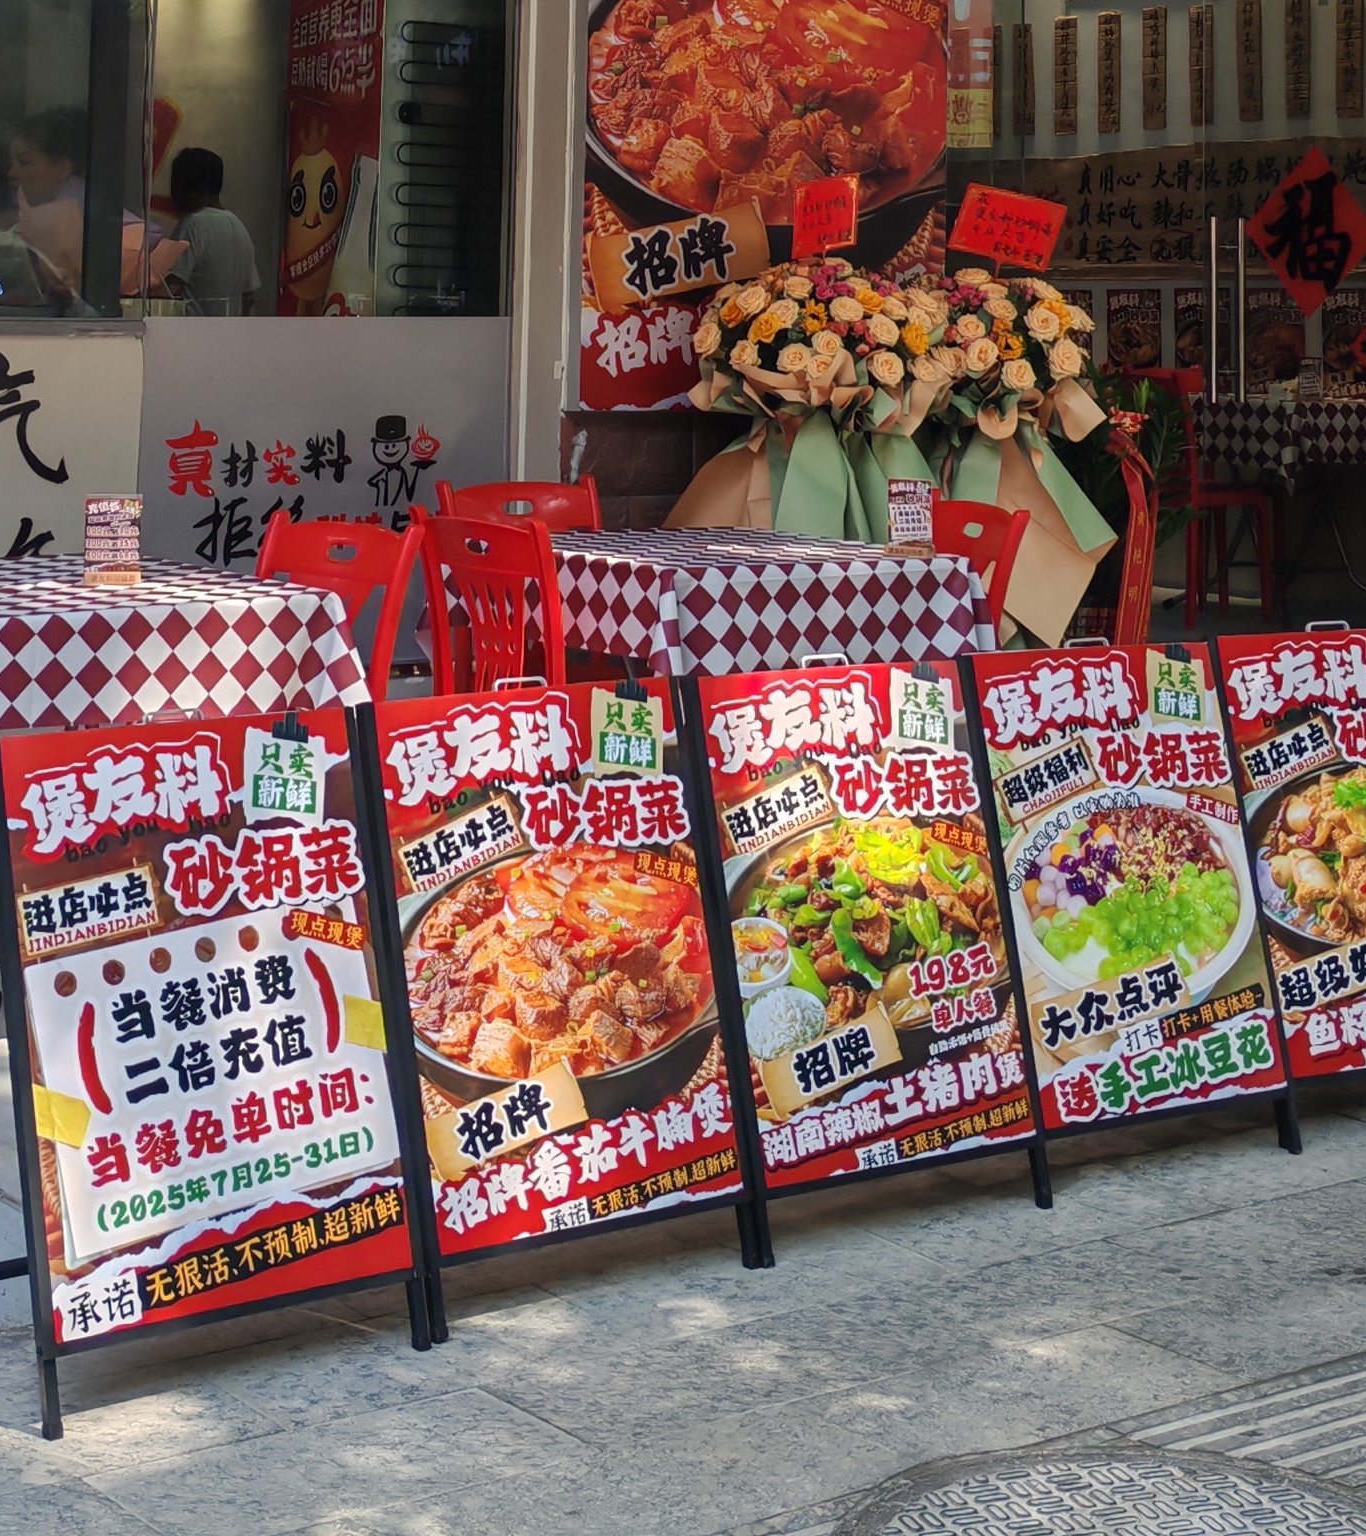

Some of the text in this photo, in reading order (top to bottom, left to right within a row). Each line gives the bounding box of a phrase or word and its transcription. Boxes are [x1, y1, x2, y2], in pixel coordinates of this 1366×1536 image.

[624, 215, 732, 294] 招牌
[1263, 171, 1351, 286] 福
[902, 681, 945, 714] 只卖
[983, 661, 1134, 745] 煲友料
[1157, 660, 1197, 694] 只卖
[1157, 688, 1198, 721] 新鲜
[603, 700, 654, 735] 只卖
[708, 682, 879, 774] 煲友料
[901, 710, 946, 744] 新鲜
[261, 743, 315, 778] 只卖
[387, 704, 573, 807] 煲友料
[603, 732, 653, 768] 新鲜
[1001, 742, 1090, 808] 超级福利
[1098, 731, 1229, 787] 砂锅菜
[1245, 721, 1330, 781] 进店必点
[20, 745, 223, 854] 煲友料
[257, 776, 313, 812] 新鲜
[525, 780, 688, 847] 砂锅菜
[726, 775, 825, 842] 进店必点
[835, 756, 975, 816] 砂锅菜
[1021, 775, 1085, 816] CHAOJIFULI
[1188, 792, 1239, 824] 手工制作
[169, 826, 359, 910] 砂锅菜
[404, 803, 515, 881] 进店必点
[933, 821, 989, 855] 现点现煲
[635, 853, 698, 888] 现点现煲
[23, 871, 154, 937] 进店必点
[27, 909, 158, 954] JINDIANBIDIAN
[290, 910, 364, 950] 现点现煲
[111, 955, 297, 1044] 当餐消费
[931, 988, 996, 1033] 单人餐
[1041, 960, 1184, 1051] 大众点评
[126, 1014, 313, 1105] 二倍充值
[794, 1026, 875, 1093] 招牌
[1124, 1019, 1160, 1053] 打卡
[1057, 1018, 1271, 1122] 送手工冰豆花
[457, 1083, 550, 1160] 招牌
[761, 1050, 1024, 1168] 湖南辣椒土猪肉煲
[441, 1082, 733, 1235] 招牌番茄牛腩煲
[861, 1142, 896, 1170] 承诺
[548, 1201, 589, 1232] 承诺
[146, 1188, 401, 1307] 无狠活、不预制、超新鲜
[67, 1279, 137, 1334] 承诺
